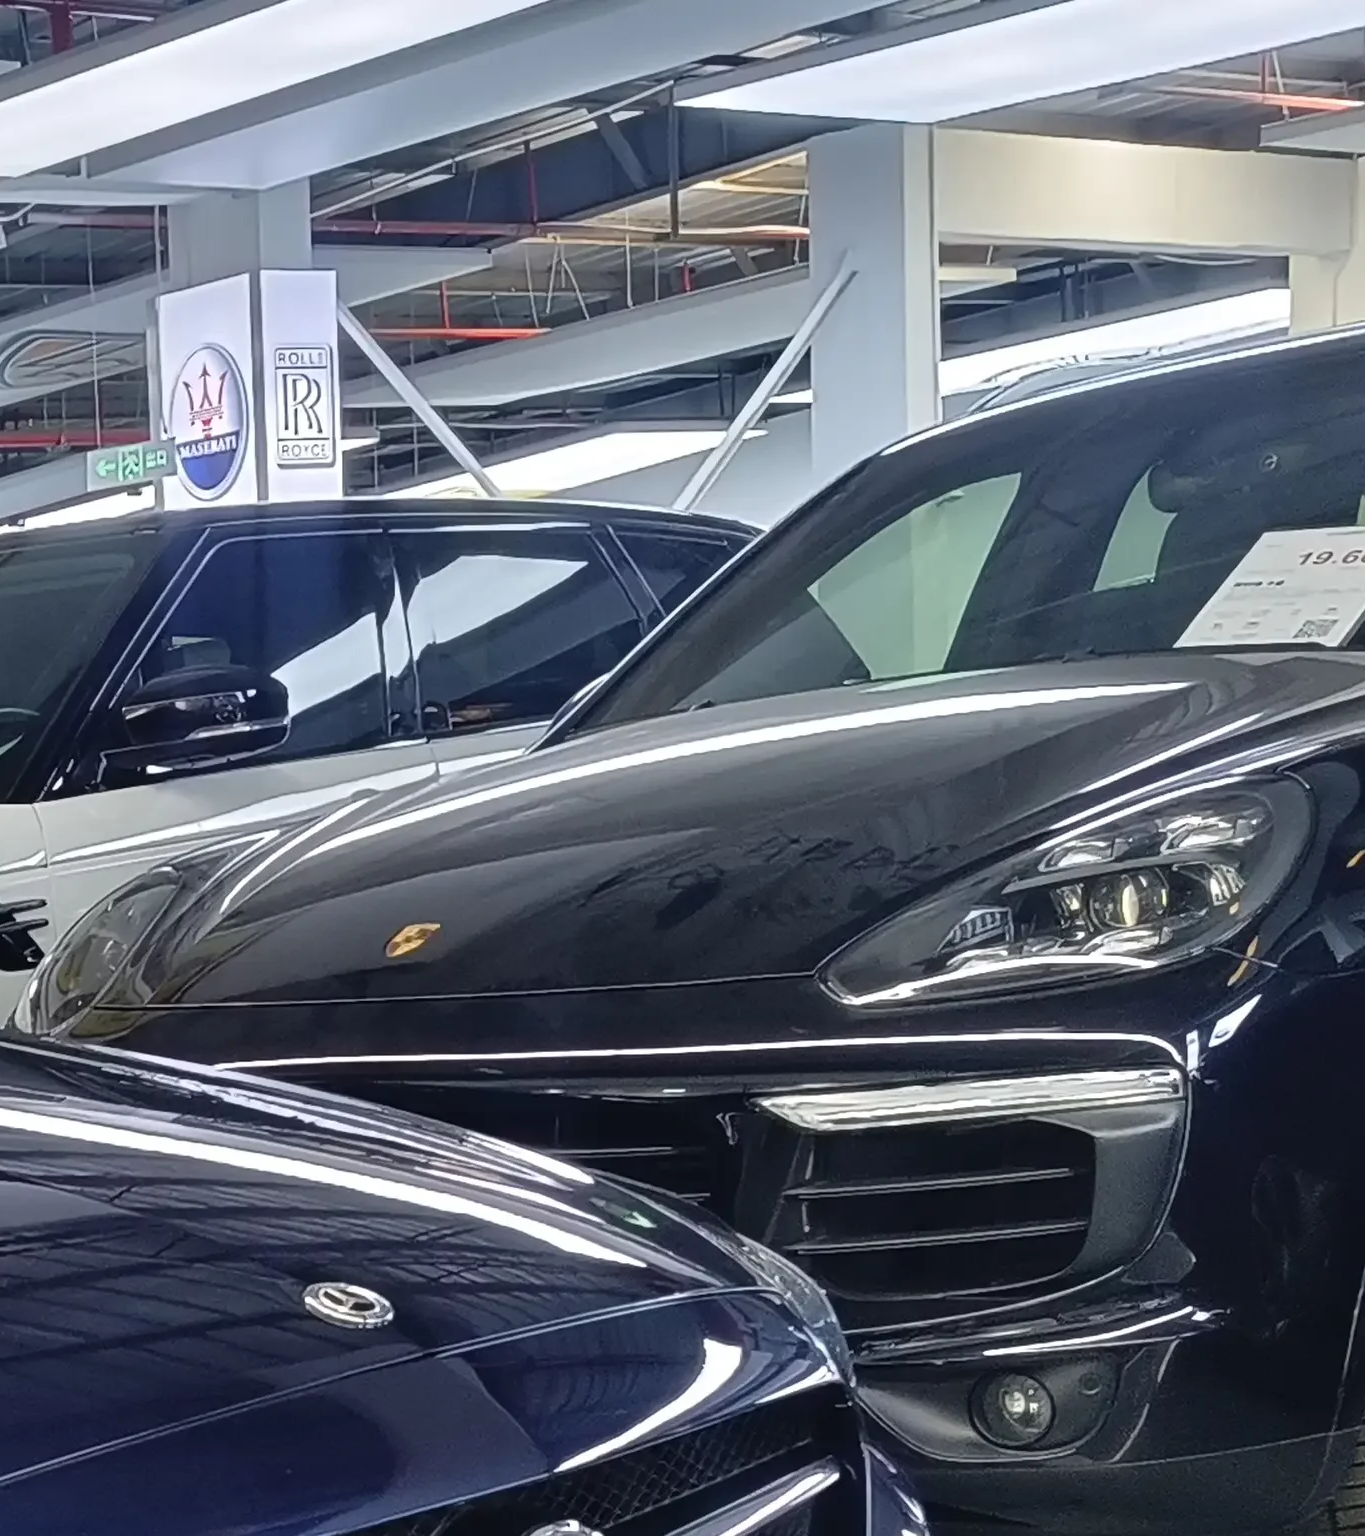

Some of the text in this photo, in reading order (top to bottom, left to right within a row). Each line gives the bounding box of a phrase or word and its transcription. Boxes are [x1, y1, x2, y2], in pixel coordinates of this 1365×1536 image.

[178, 434, 238, 458] MASERATI
[281, 444, 327, 457] ROYCE
[1299, 549, 1365, 566] 19.6
